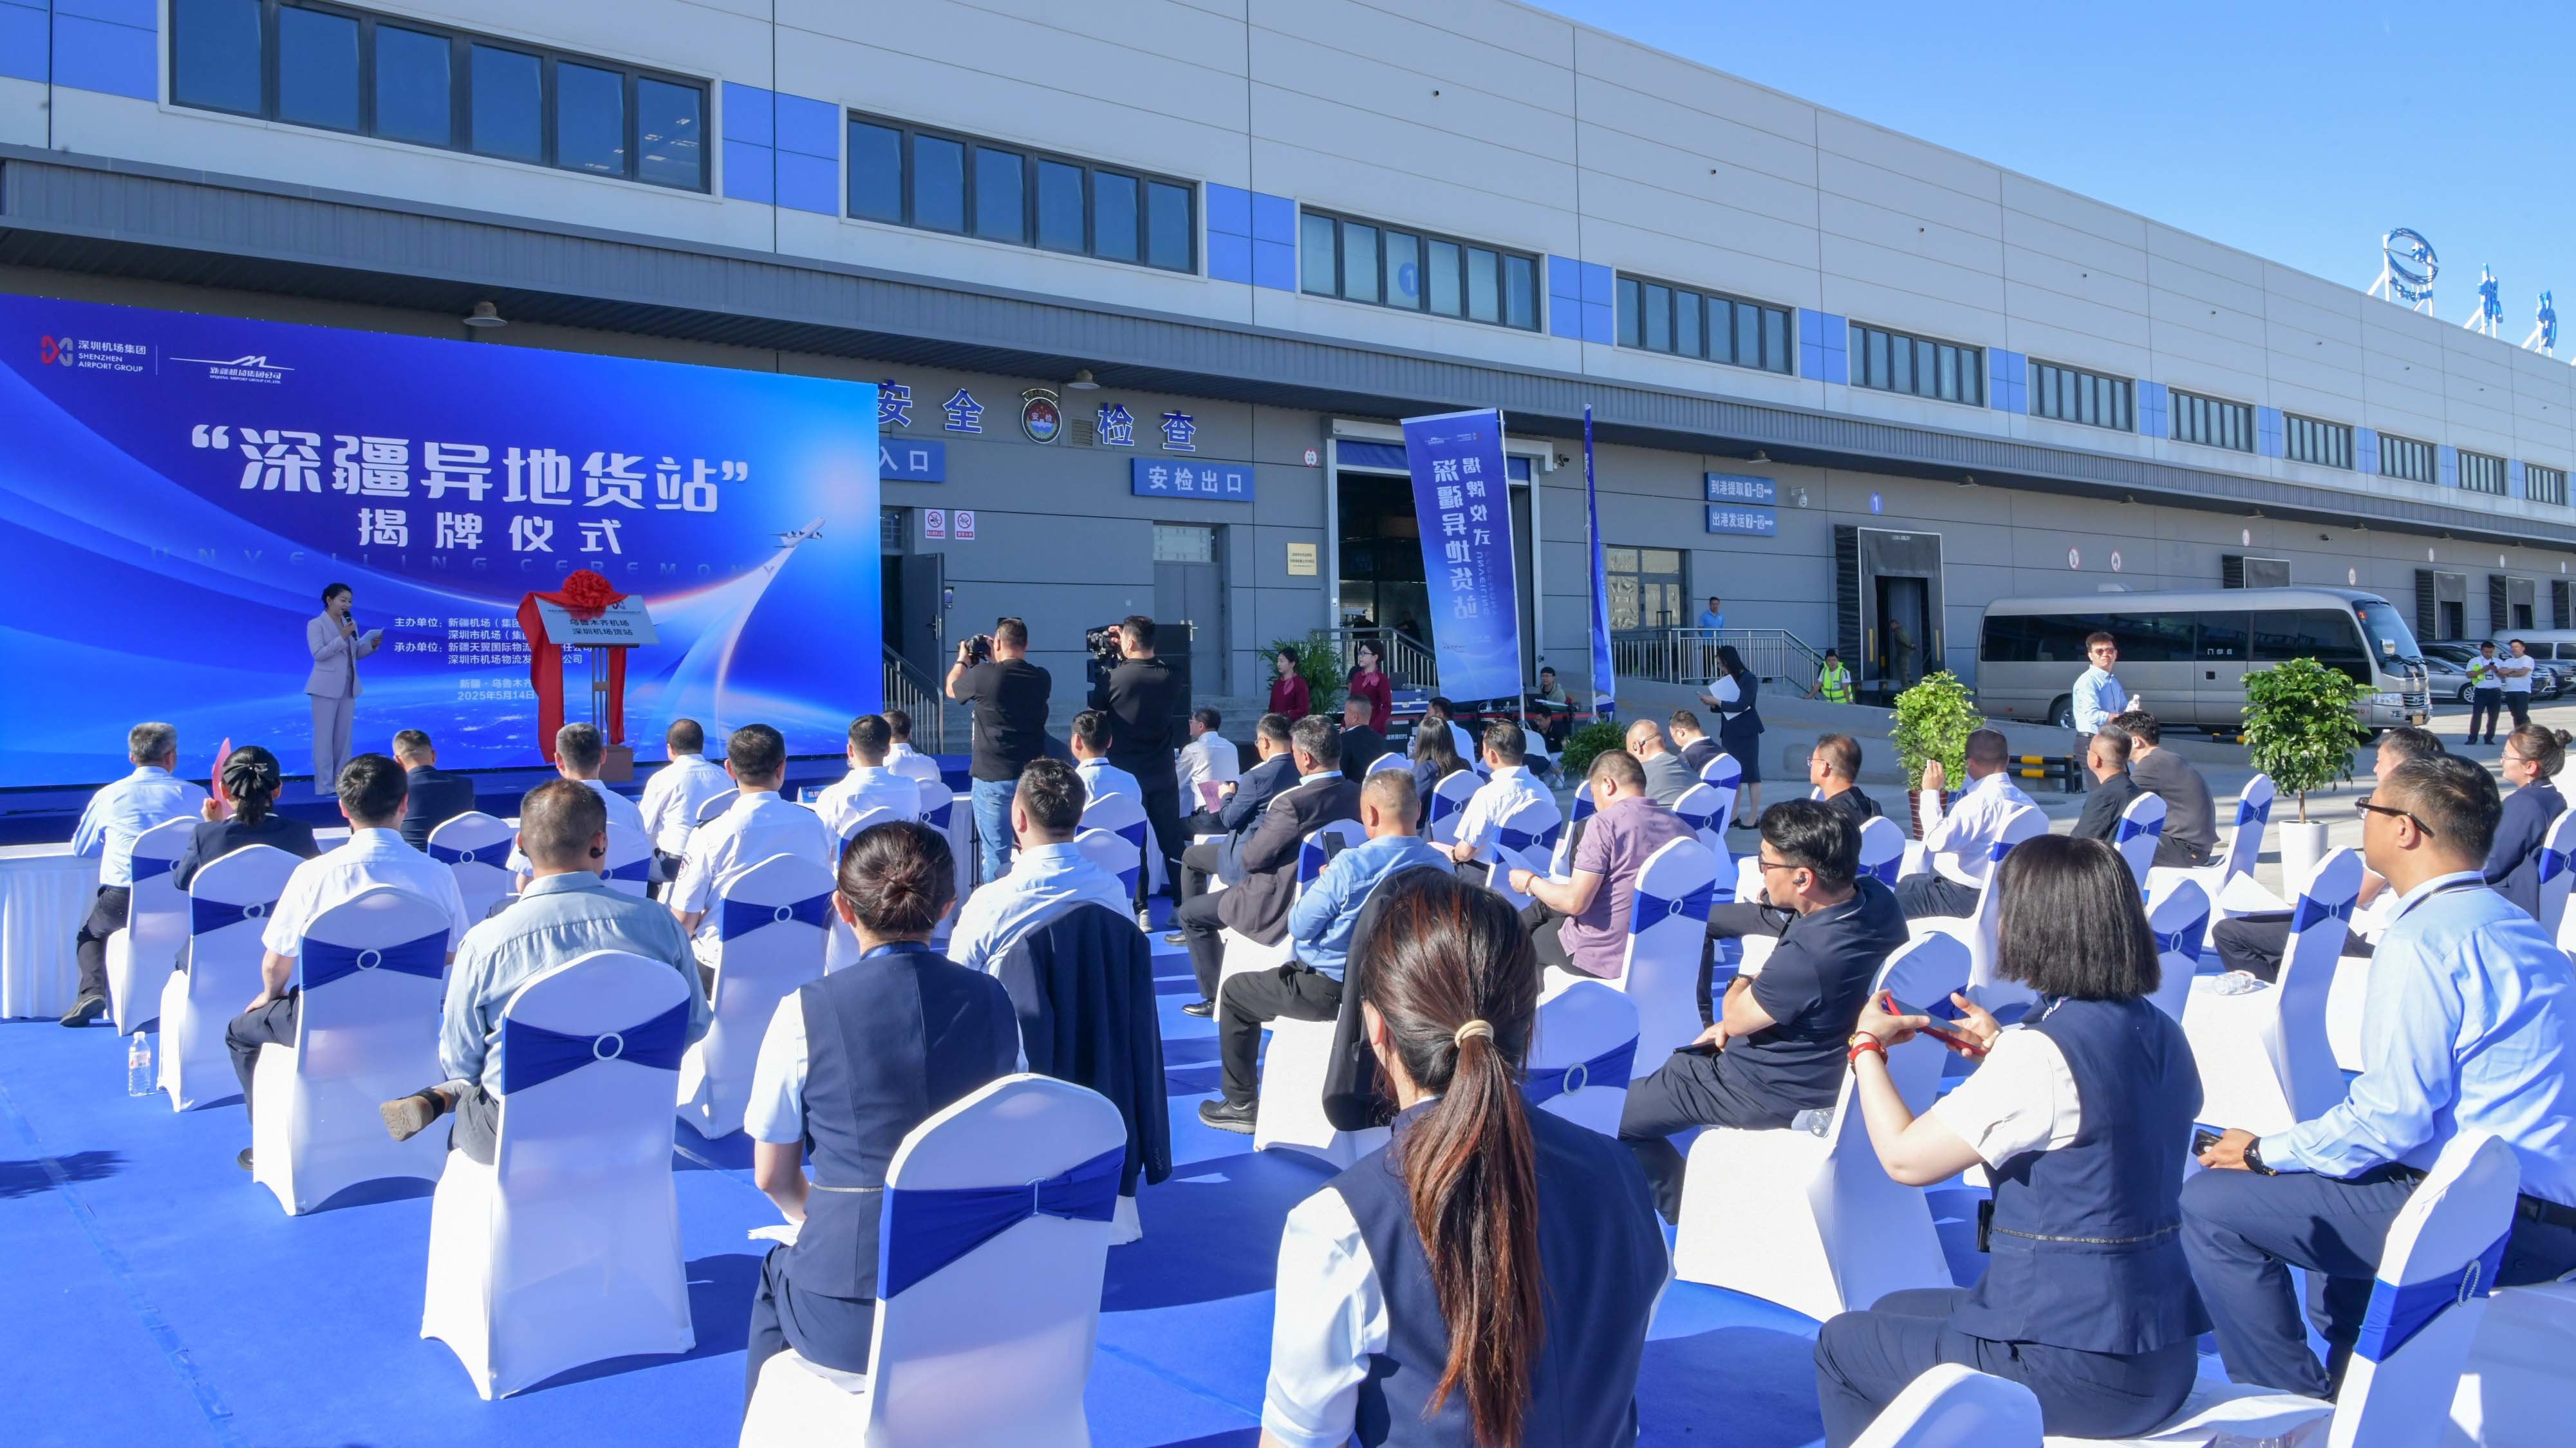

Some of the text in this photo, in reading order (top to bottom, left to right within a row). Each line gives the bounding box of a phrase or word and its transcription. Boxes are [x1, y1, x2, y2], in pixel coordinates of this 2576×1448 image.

[78, 339, 146, 355] 深圳机场集团
[78, 353, 123, 362] SHENZHEN
[78, 361, 144, 373] AIRPORT GROUP
[1097, 402, 1196, 452] 检查
[191, 423, 749, 513] “深疆异地货站”
[1148, 465, 1242, 494] 安检出口
[357, 507, 622, 554] 揭牌仪式
[563, 654, 583, 664] 公司
[458, 691, 535, 701] 2025年5月14日
